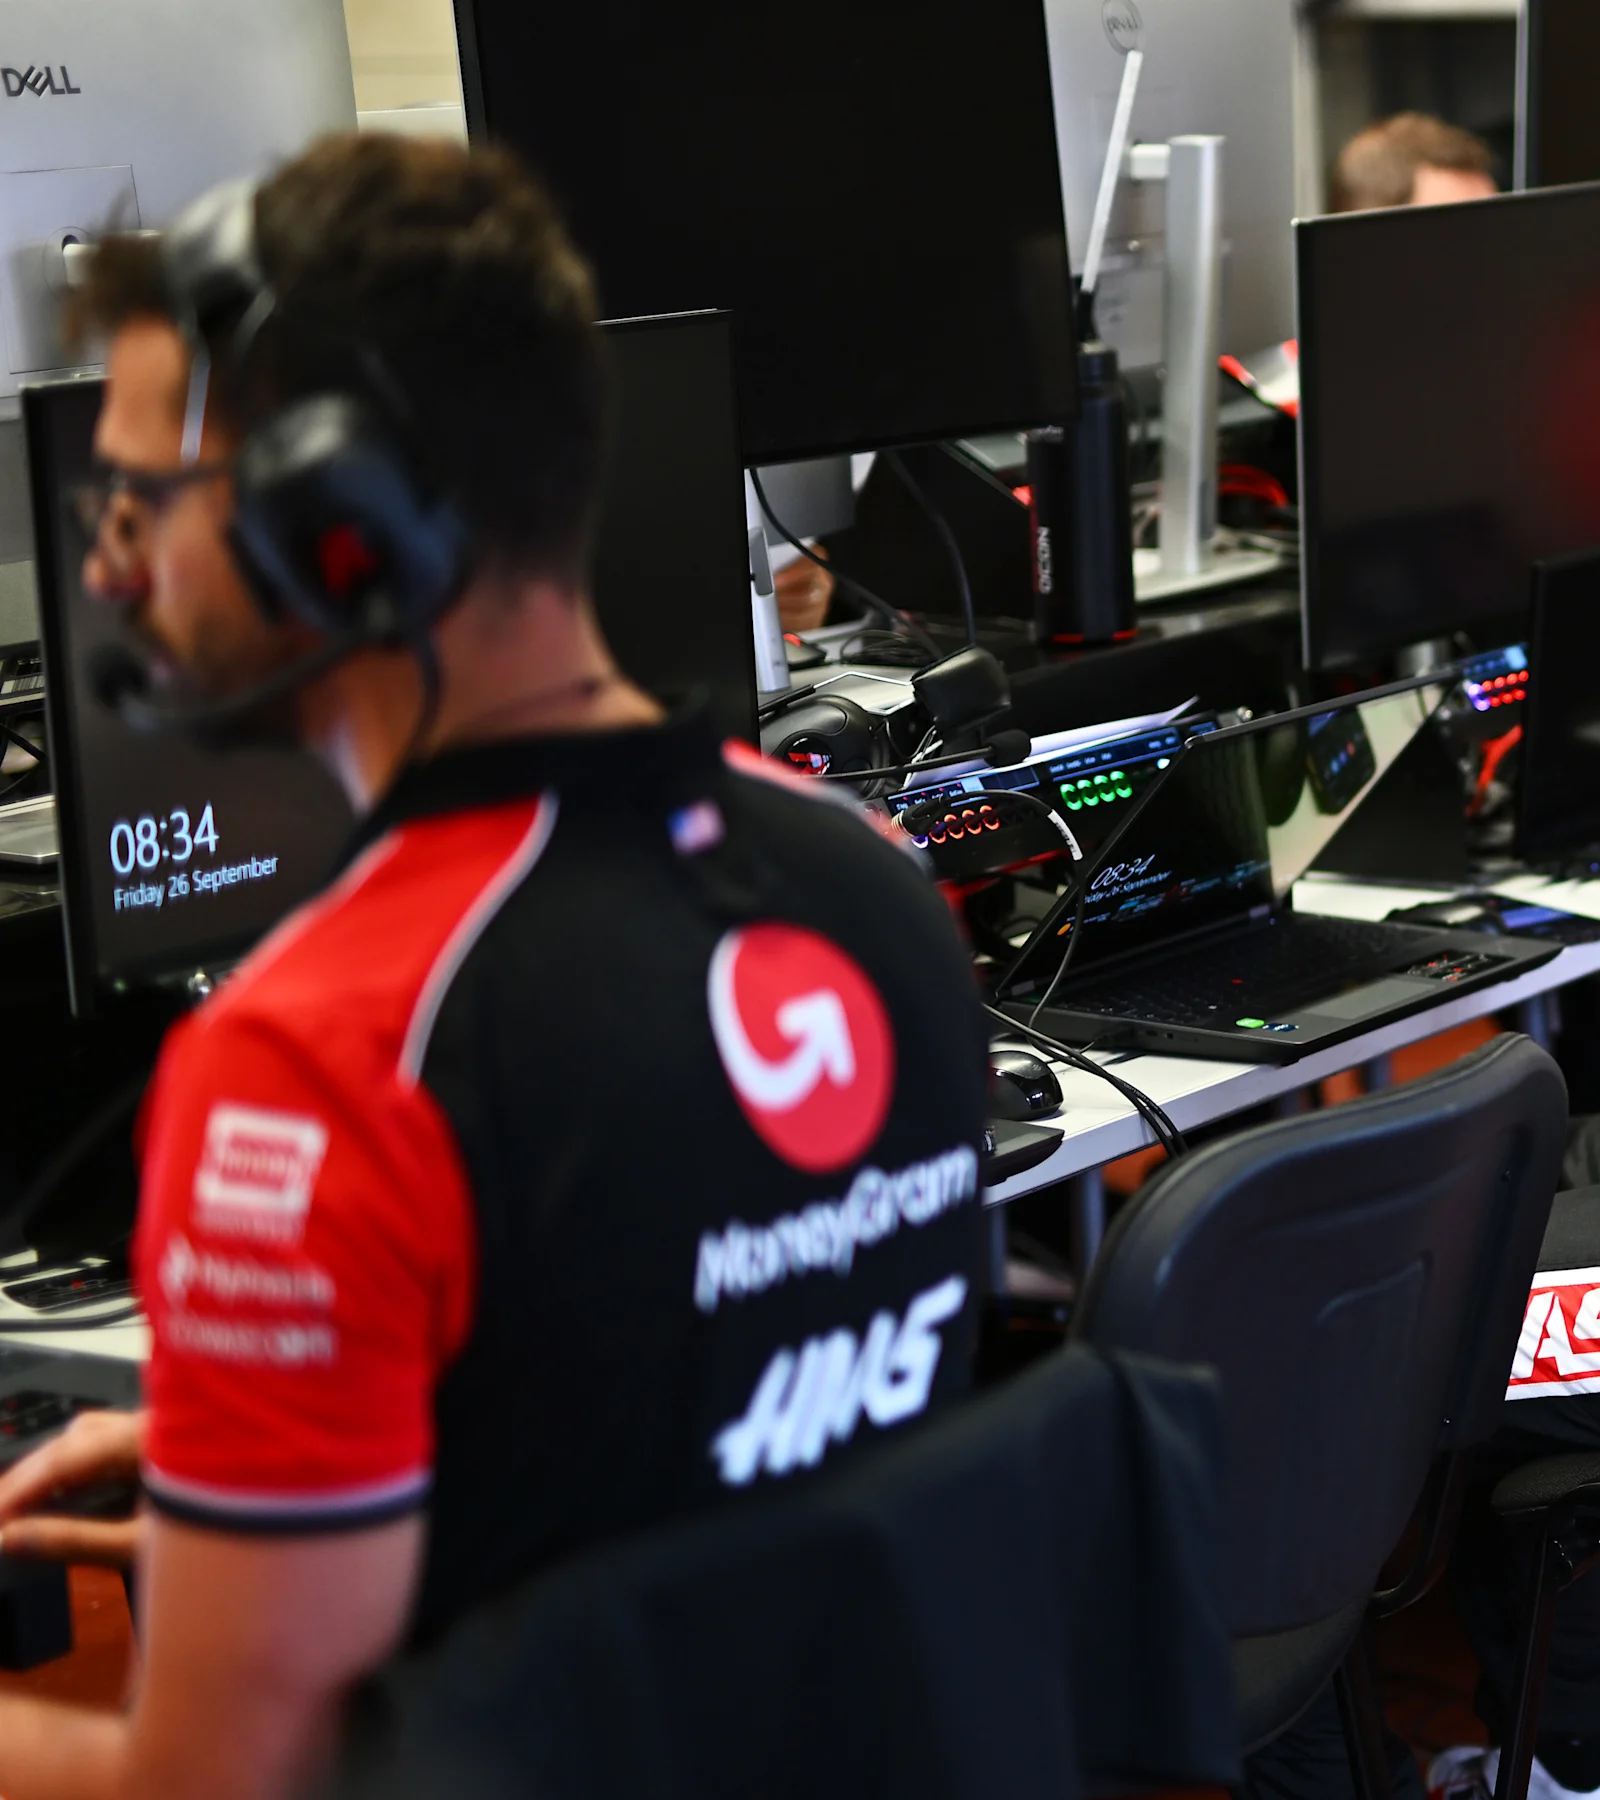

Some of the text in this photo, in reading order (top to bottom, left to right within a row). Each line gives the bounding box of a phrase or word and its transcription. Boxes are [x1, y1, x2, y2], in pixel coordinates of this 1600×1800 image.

[0, 66, 82, 97] DELL
[110, 803, 220, 873] 08:34
[113, 856, 280, 911] Friday 26 September
[1090, 853, 1156, 890] 08:34
[695, 1144, 978, 1316] MoneyGram
